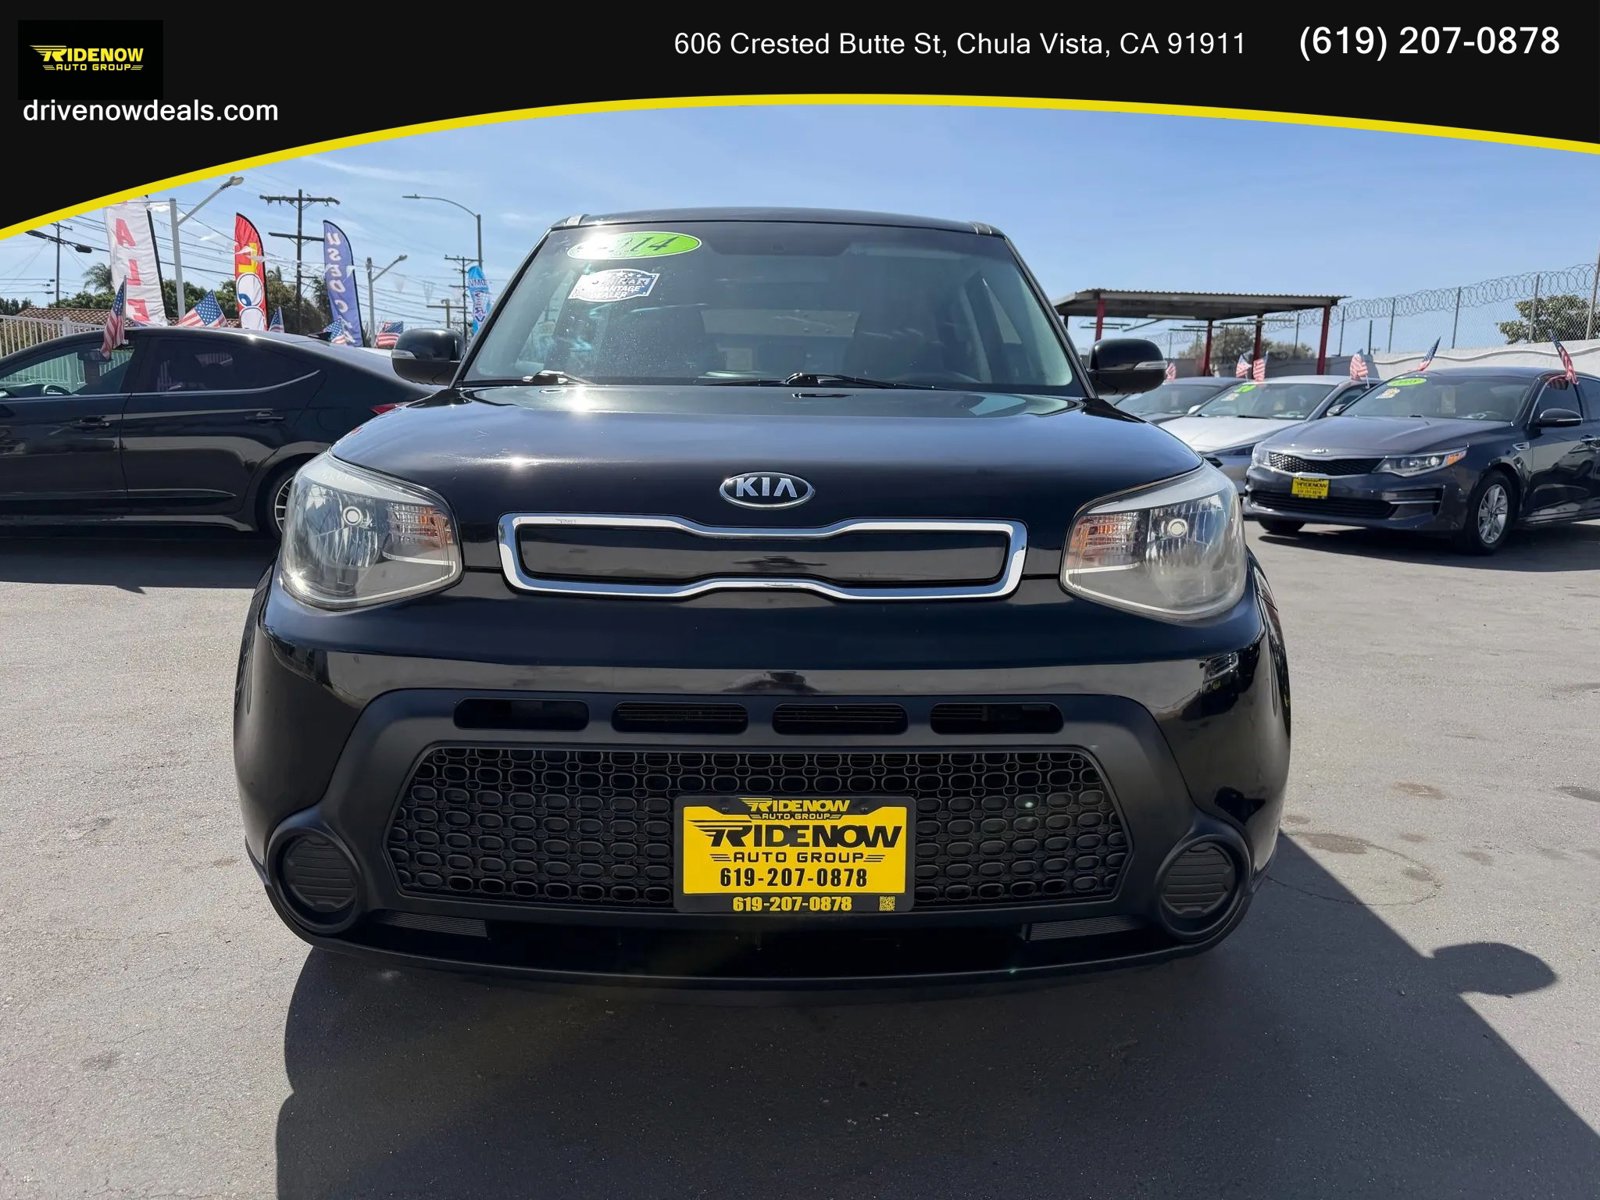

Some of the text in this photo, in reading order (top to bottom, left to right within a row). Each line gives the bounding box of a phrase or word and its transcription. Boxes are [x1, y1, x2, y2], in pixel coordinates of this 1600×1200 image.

[736, 477, 798, 498] KIA
[738, 798, 851, 812] RIDENOW
[687, 820, 903, 848] RIDENOW
[733, 852, 864, 863] AUTO GROUP
[720, 867, 868, 888] 619-207-0878
[732, 896, 853, 912] 619-207-0878
